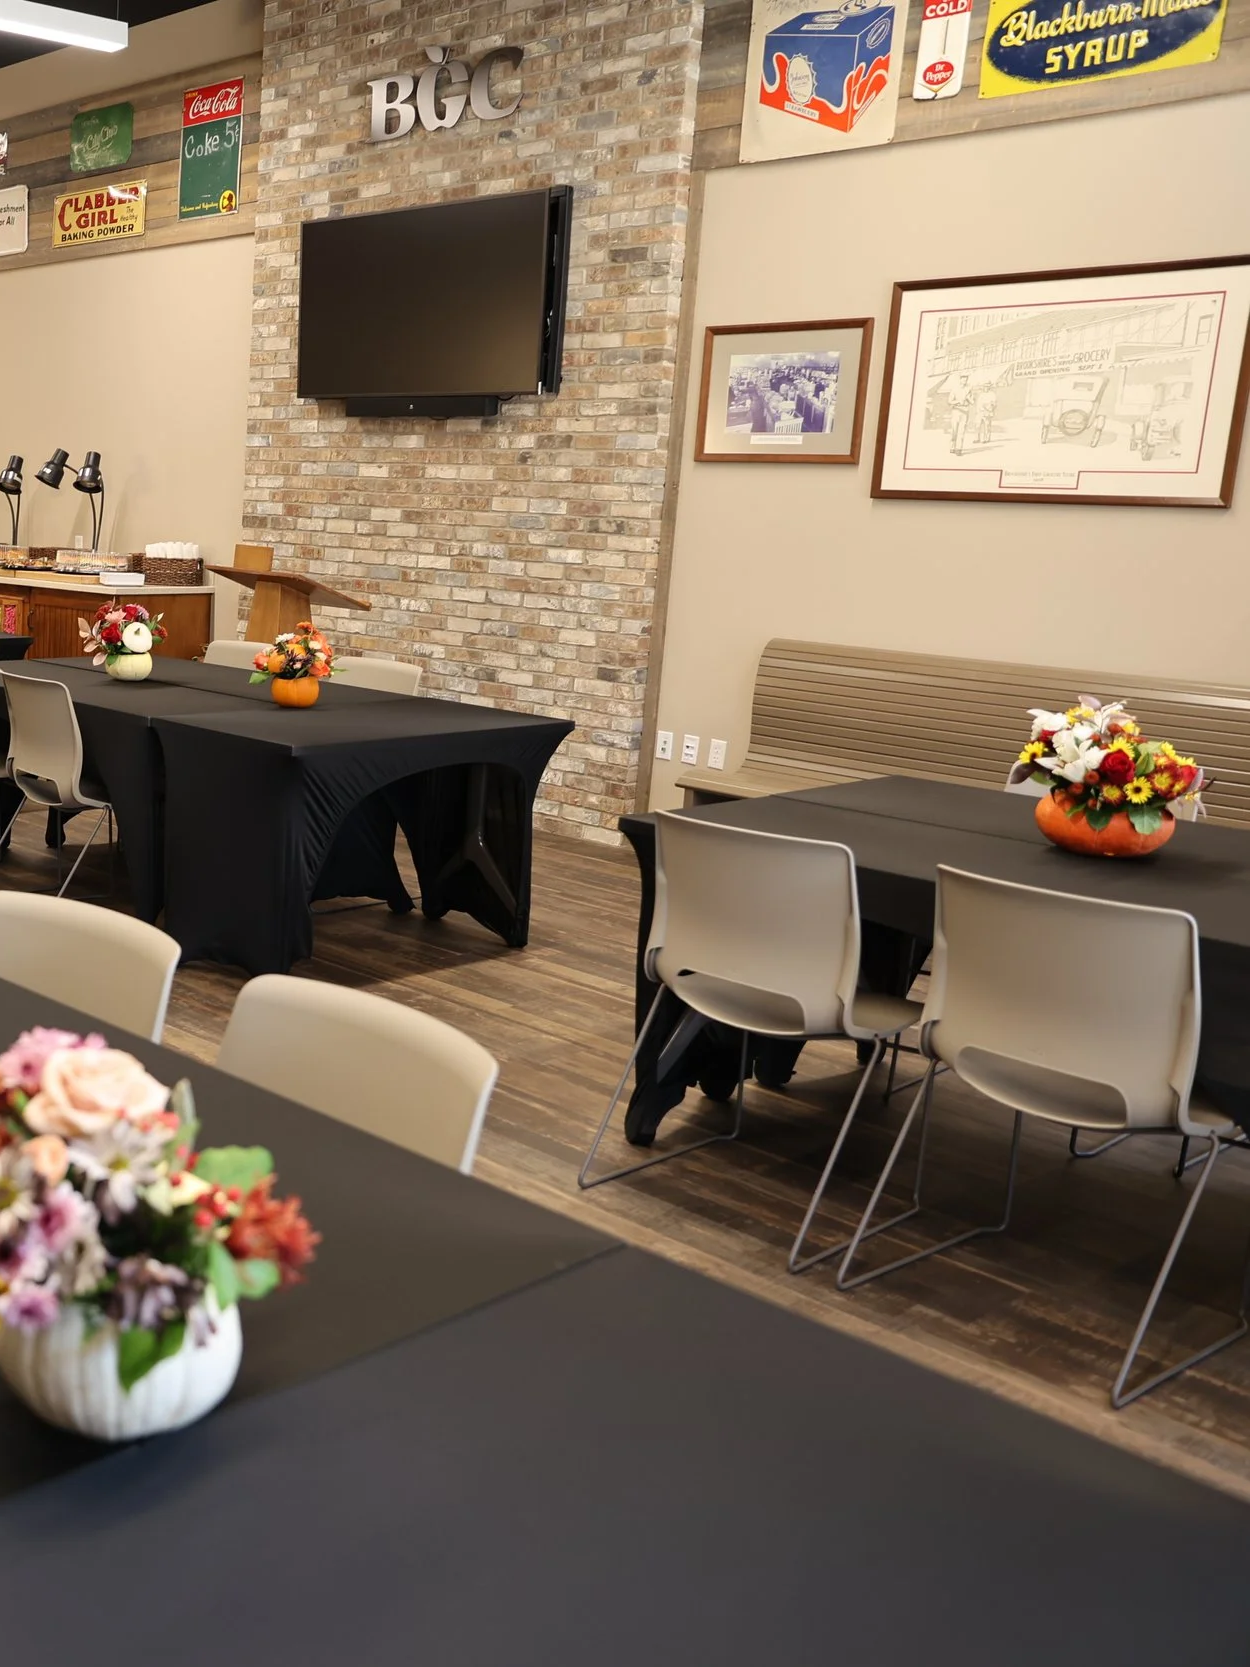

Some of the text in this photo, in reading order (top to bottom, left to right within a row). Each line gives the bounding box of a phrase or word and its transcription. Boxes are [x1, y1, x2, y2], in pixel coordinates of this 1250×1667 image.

[925, 0, 967, 17] COLD
[1045, 29, 1149, 74] SYRUP
[925, 70, 953, 83] Pepper
[935, 63, 945, 72] Dr
[189, 85, 240, 119] Coca-Cola
[365, 46, 525, 143] BGC
[185, 120, 240, 158] Coke 5¢
[58, 186, 140, 231] CLABBER
[76, 208, 118, 229] GIRL
[6, 216, 15, 226] All
[61, 223, 134, 242] BAKING POWDER
[1073, 348, 1111, 364] GROCERY
